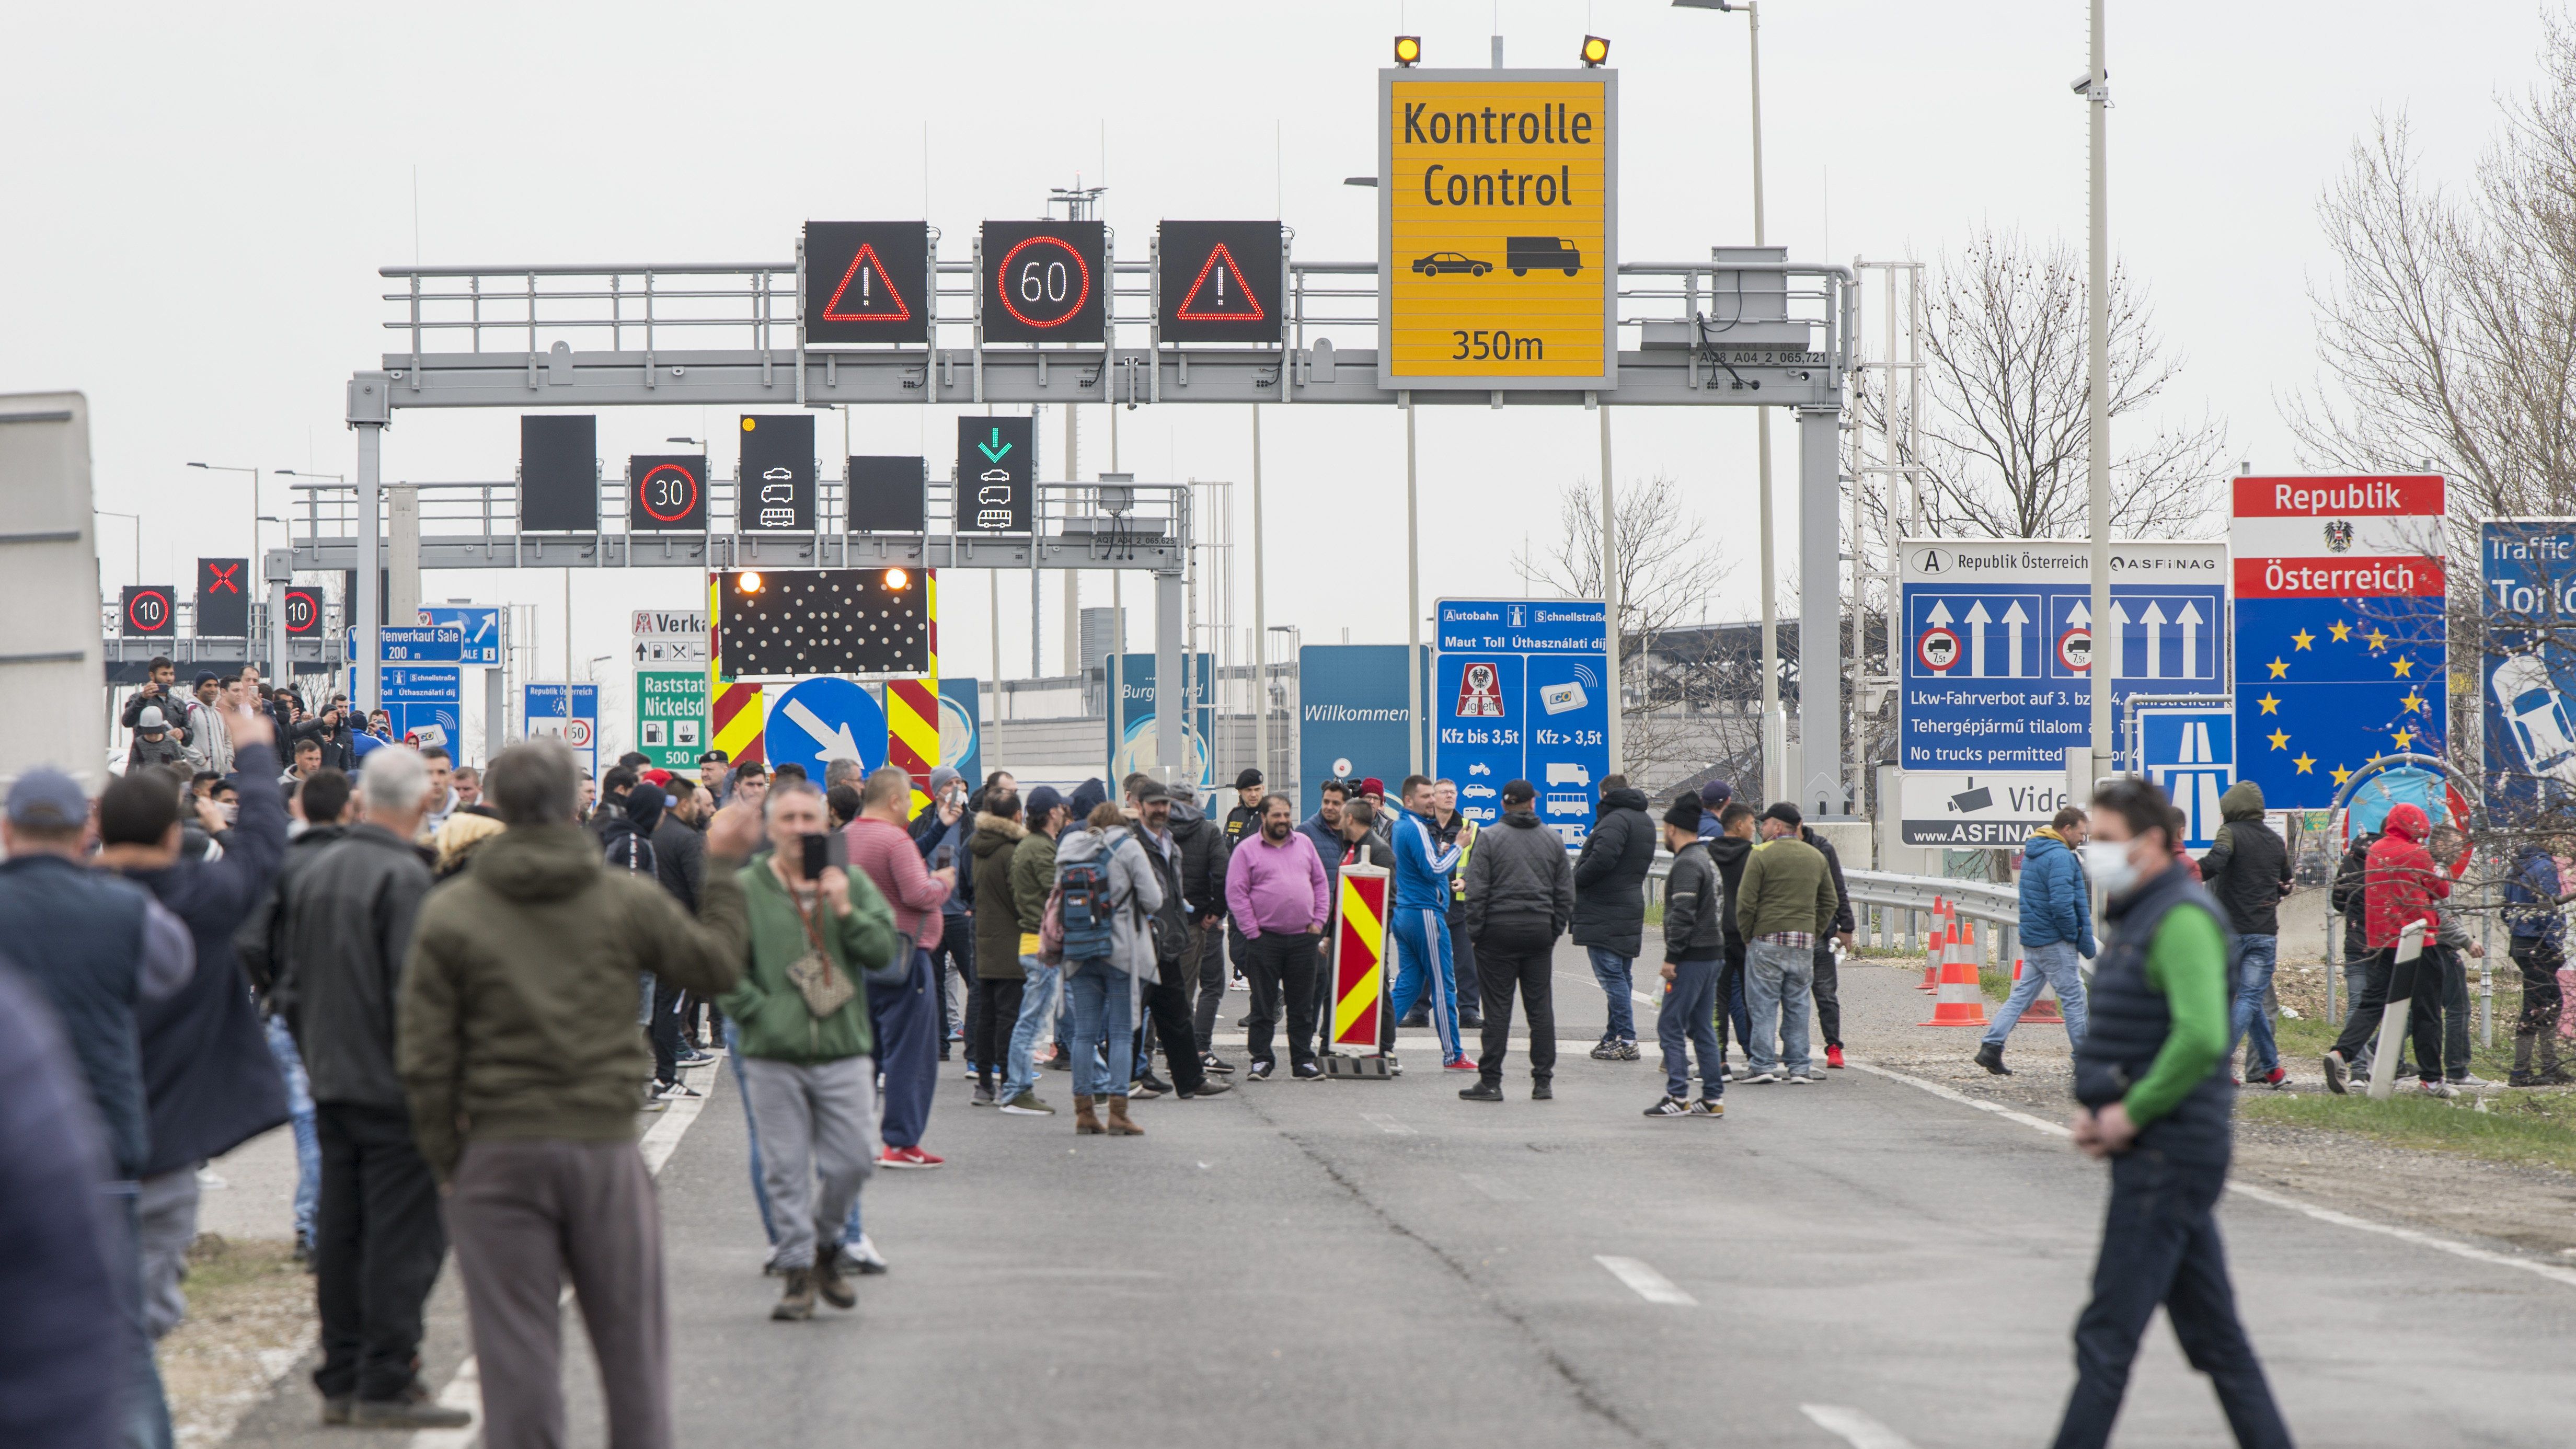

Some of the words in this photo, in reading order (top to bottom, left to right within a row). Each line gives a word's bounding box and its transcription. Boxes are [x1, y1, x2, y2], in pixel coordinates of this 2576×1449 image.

[1405, 102, 1592, 144] Kontrolle
[1424, 164, 1572, 206] Control
[1021, 261, 1067, 302] 60
[1453, 330, 1544, 360] 350m
[655, 479, 683, 506] 30
[2275, 481, 2401, 515] Republik
[2488, 535, 2570, 559] Traffic
[1924, 550, 1940, 572] A
[1958, 554, 2017, 571] Republik
[2022, 552, 2089, 569] Österreich
[2265, 558, 2414, 591] Österreich
[140, 601, 159, 620] 10
[288, 602, 307, 621] 10
[1445, 611, 1499, 621] Autobahn
[656, 614, 705, 632] Verk
[437, 629, 459, 642] Sale
[1445, 636, 1476, 648] Maut
[1483, 636, 1505, 648] Toll
[1512, 635, 1588, 649] Úthasználati
[388, 647, 407, 660] 200
[1933, 653, 1946, 663] 7,5t
[2073, 653, 2085, 664] 7,5t
[446, 688, 455, 697] díj
[530, 686, 558, 696] Republik
[1911, 691, 2026, 706] Lkw-Fahrverbot
[2030, 692, 2055, 706] auf
[2057, 692, 2069, 706] 3.
[2075, 692, 2091, 706] bz
[2111, 692, 2124, 706] 4.
[557, 700, 566, 711] A
[645, 696, 705, 717] Nickelsd
[1305, 704, 1409, 721] Willkommen
[1459, 698, 1501, 714] Vignette
[572, 727, 584, 739] 50
[1911, 718, 2024, 736] Tehergépjármű
[2029, 719, 2083, 733] tilalom
[1442, 728, 1464, 744] Kfz
[1467, 728, 1489, 744] bis
[1491, 729, 1519, 746] 3,5t
[1537, 729, 1559, 744] Kfz
[1575, 730, 1602, 746] 3,5t
[665, 751, 689, 764] 500
[1911, 746, 1930, 761] No
[1936, 747, 1983, 761] trucks
[1988, 746, 2063, 764] permitted
[2008, 785, 2067, 812] Vide
[1914, 824, 2053, 842] www.ASFINA
